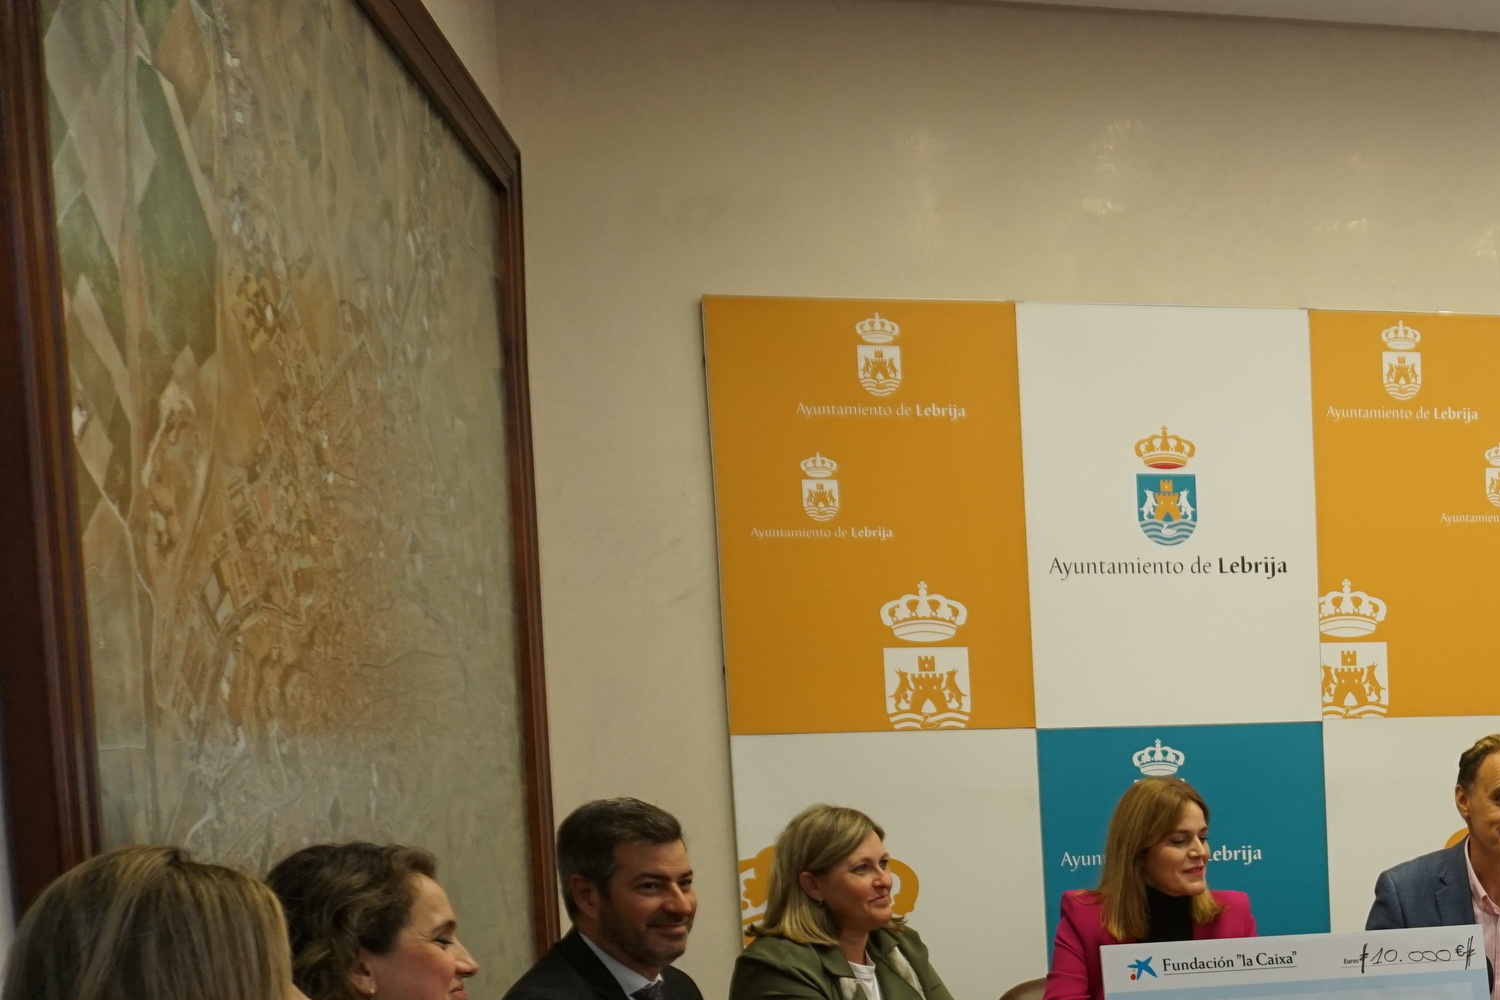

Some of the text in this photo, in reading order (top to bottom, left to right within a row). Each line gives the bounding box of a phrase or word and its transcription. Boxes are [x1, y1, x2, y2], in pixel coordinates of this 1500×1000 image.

[796, 402, 966, 420] Ayuntamiento de Lebrija
[1326, 405, 1479, 423] Ayuntamiento de Lebrija
[750, 526, 893, 541] Ayuntamiento de Lebrija
[1049, 556, 1288, 580] Ayuntamiento de Lebrija
[1162, 956, 1234, 972] Fundación
